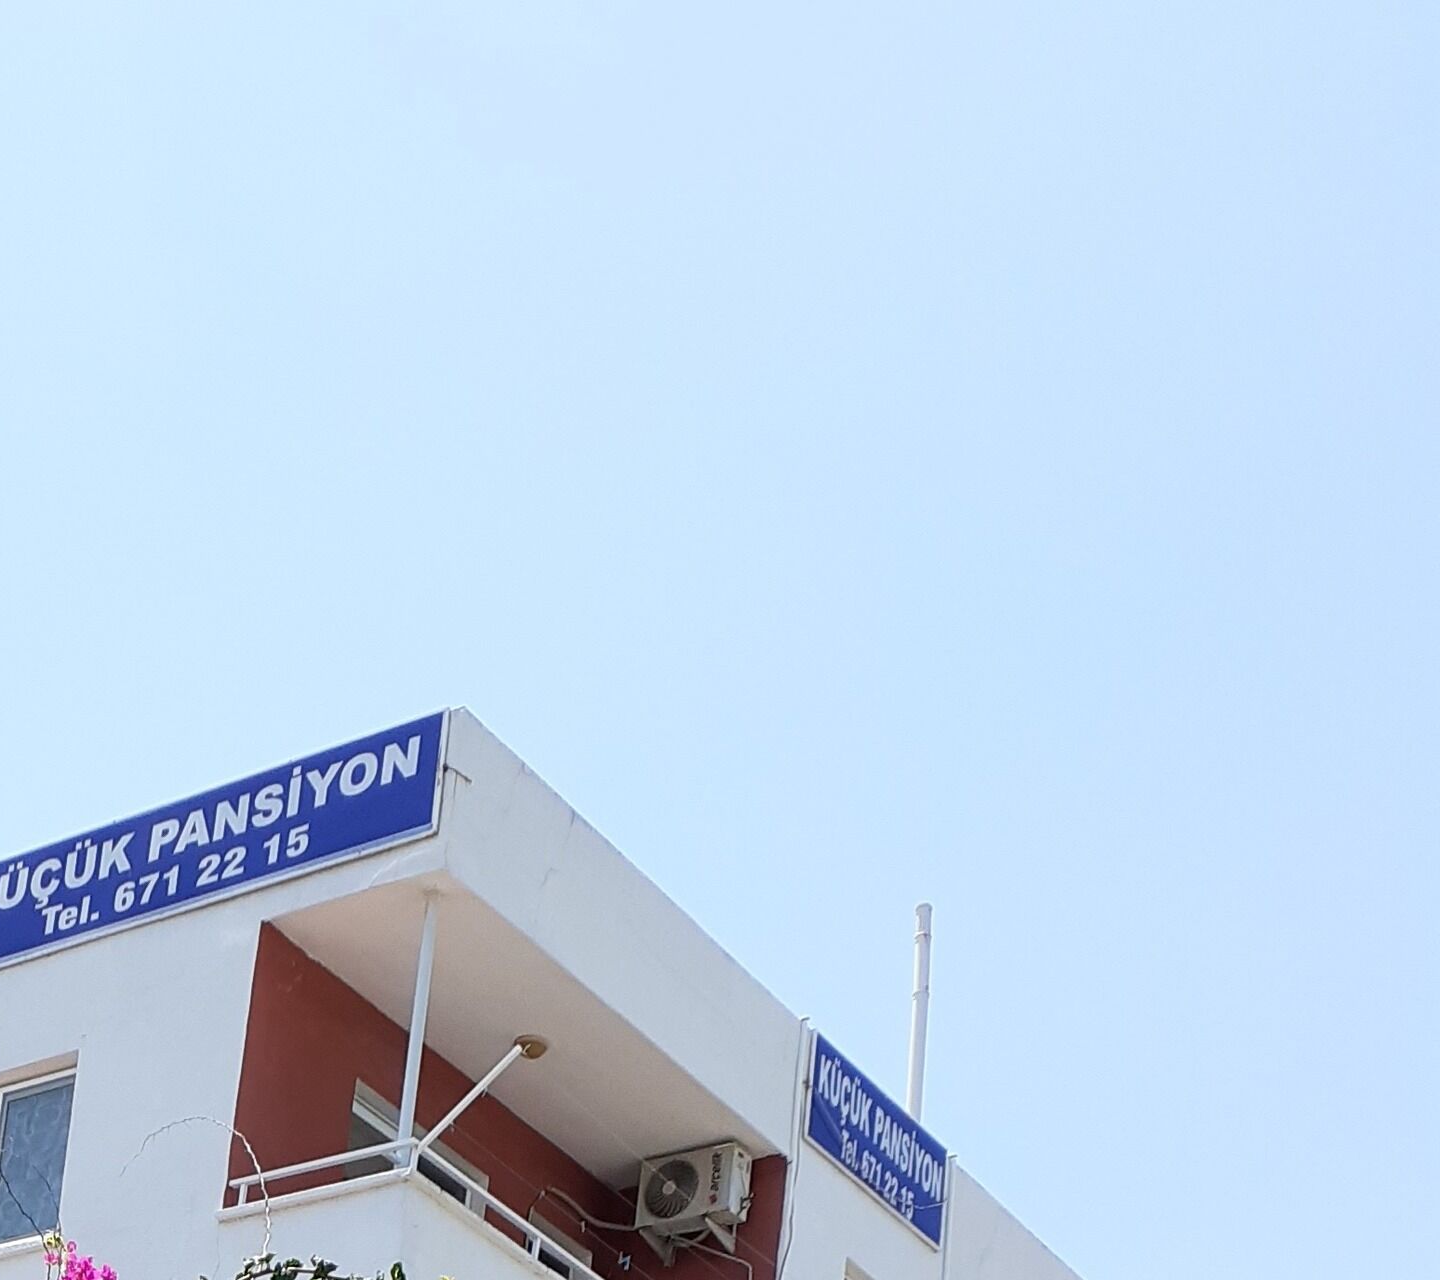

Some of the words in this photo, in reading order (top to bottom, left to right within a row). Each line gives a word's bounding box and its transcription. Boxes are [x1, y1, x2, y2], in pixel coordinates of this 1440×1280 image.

[148, 735, 422, 861] PANSİYON
[42, 896, 100, 936] Tel.
[114, 866, 181, 914] 671
[195, 846, 246, 887] 22
[264, 823, 310, 866] 15
[818, 1054, 873, 1137] KÜÇÜK
[873, 1107, 944, 1202] PANSİYON
[862, 1150, 883, 1190] 671
[884, 1172, 899, 1205] 22
[900, 1187, 915, 1220] 15
